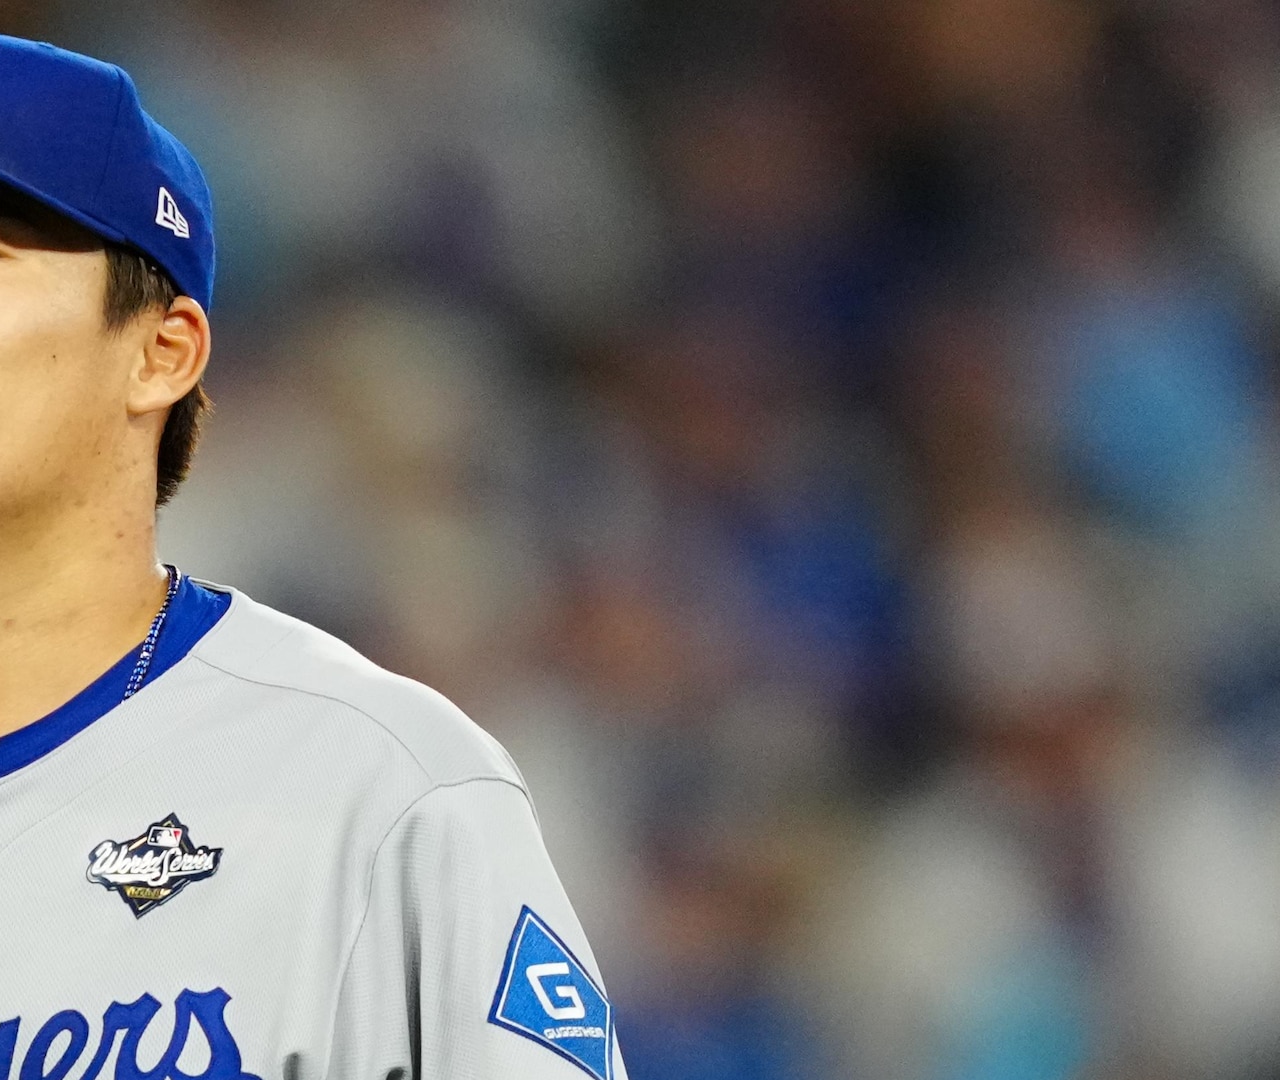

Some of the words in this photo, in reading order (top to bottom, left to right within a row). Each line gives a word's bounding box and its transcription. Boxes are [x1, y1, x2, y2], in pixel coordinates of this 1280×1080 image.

[91, 840, 167, 878] World
[148, 847, 215, 886] Series
[525, 962, 586, 1020] G
